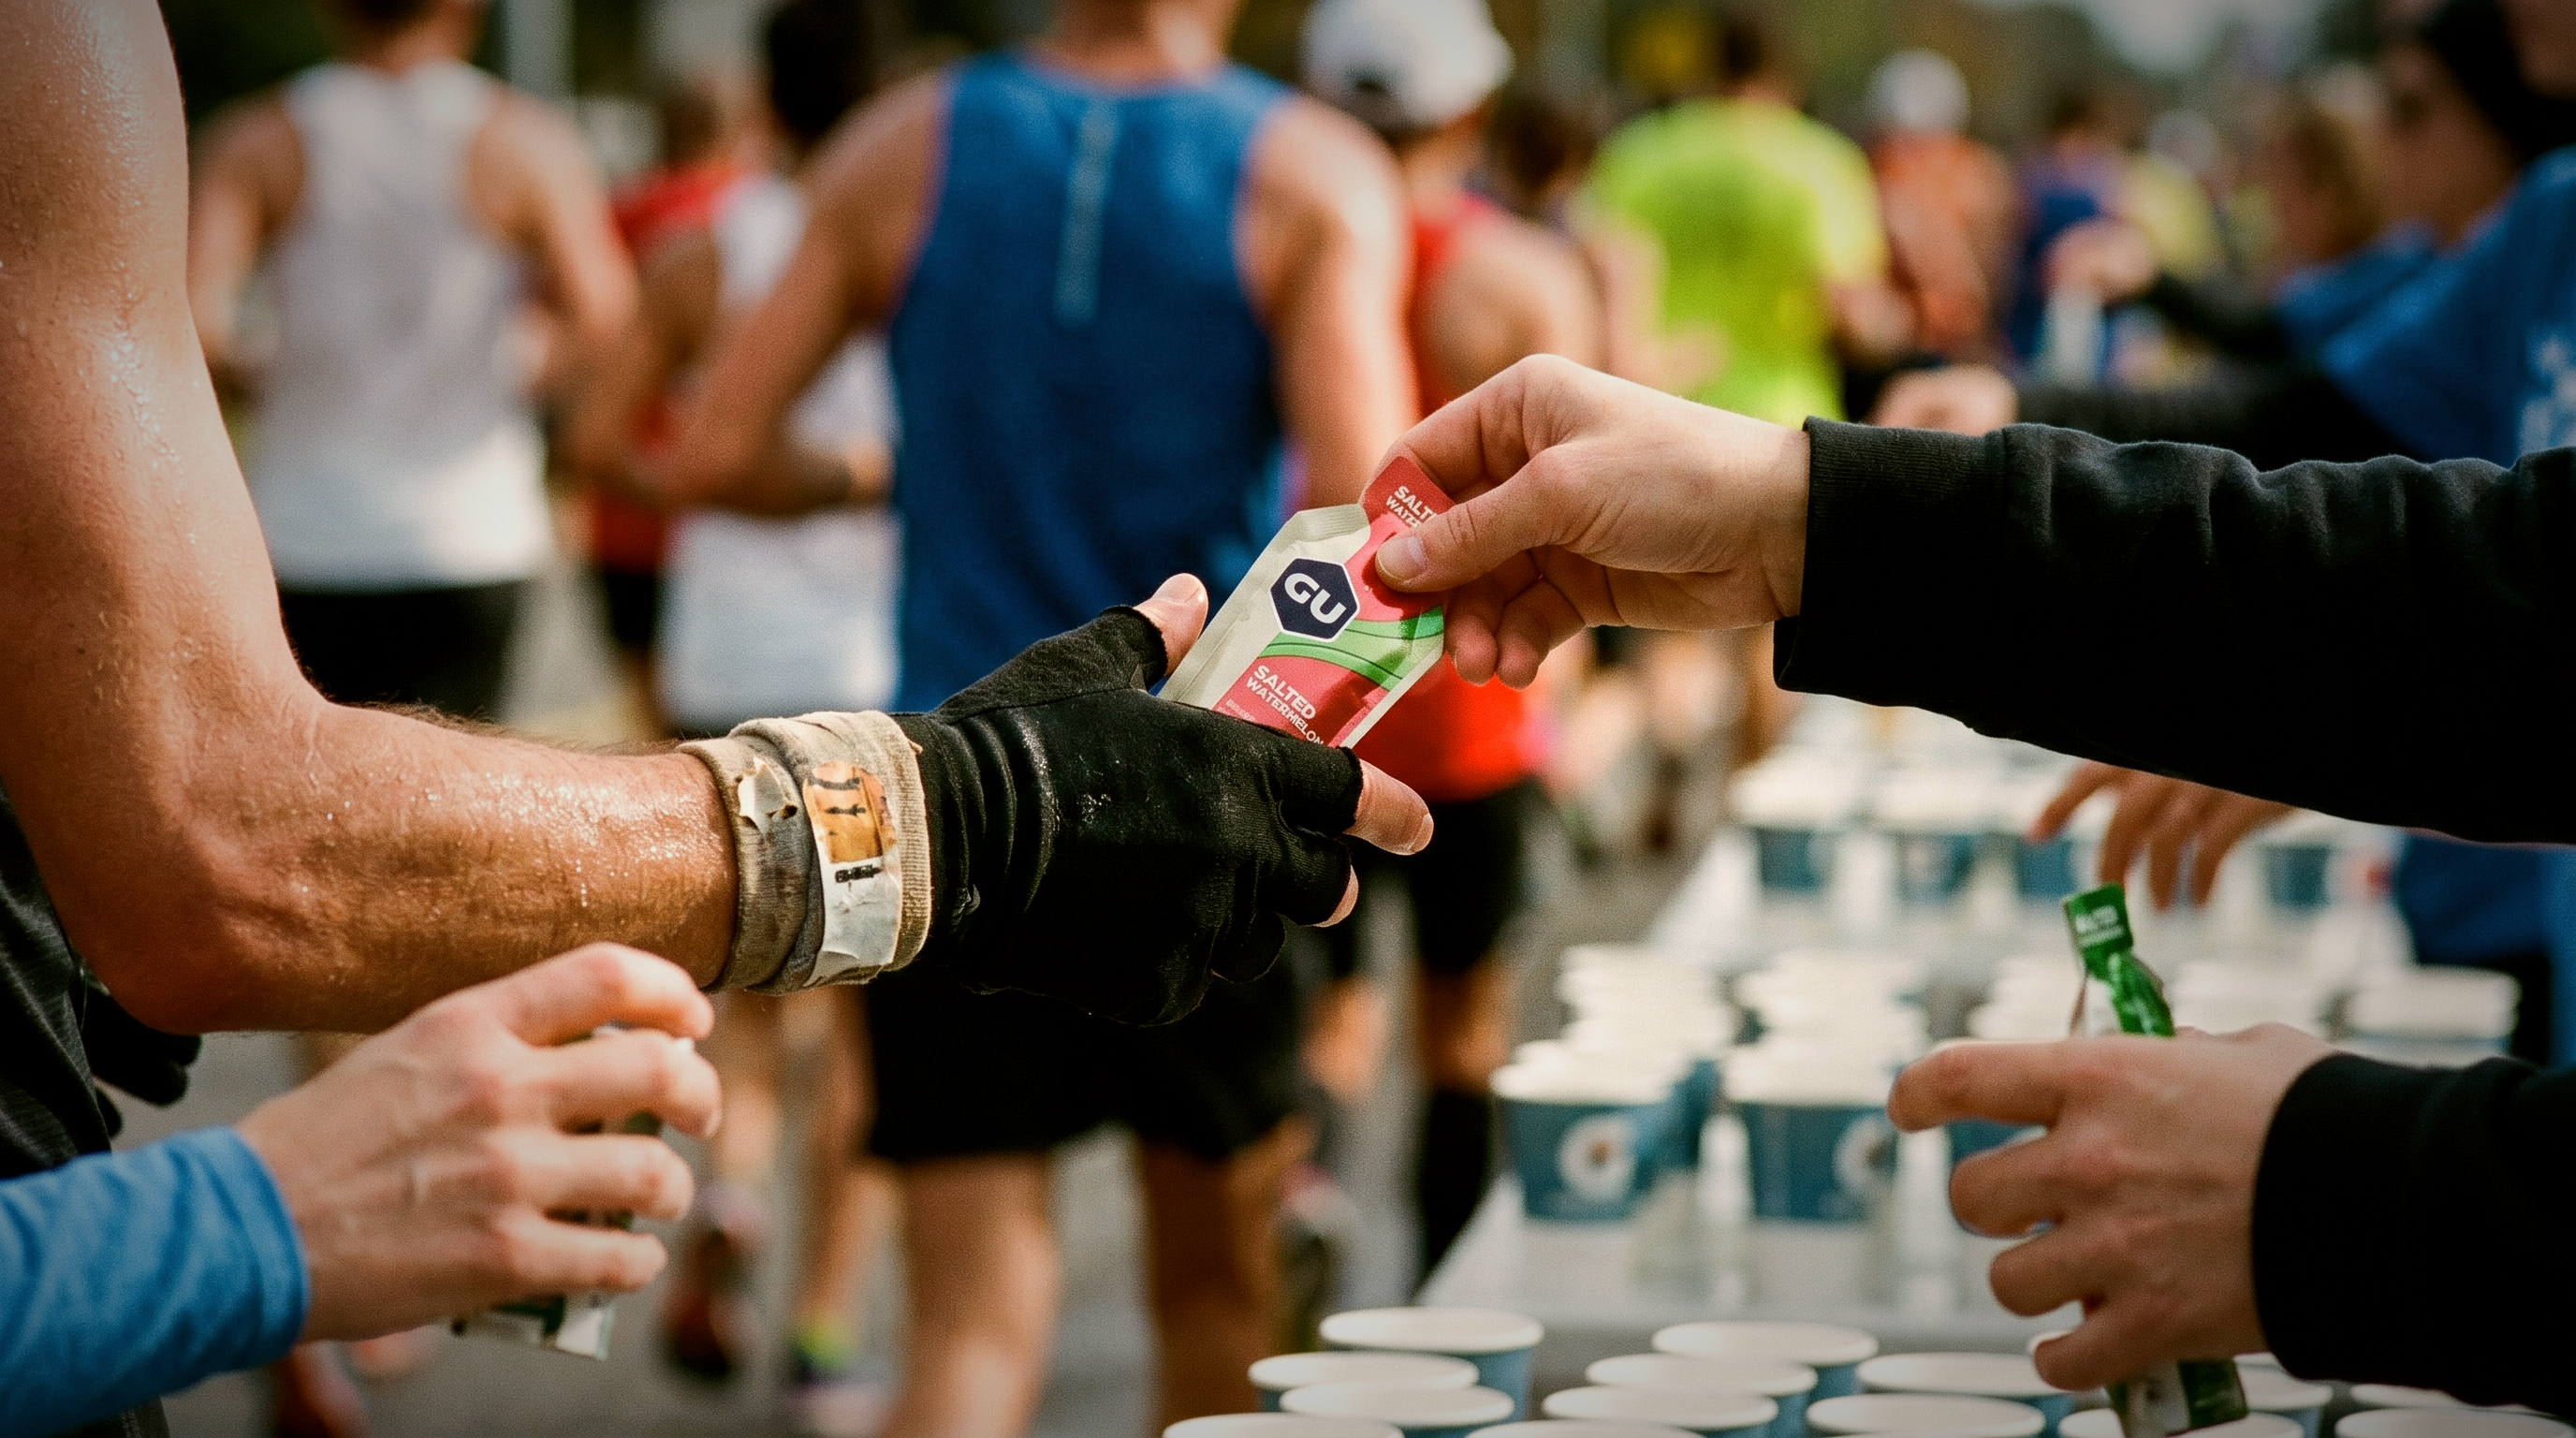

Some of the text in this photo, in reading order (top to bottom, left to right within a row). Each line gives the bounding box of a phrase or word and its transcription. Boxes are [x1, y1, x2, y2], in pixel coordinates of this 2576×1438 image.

[1394, 485, 1436, 521] SALT
[1284, 573, 1347, 624] GU
[1253, 665, 1316, 720] SALTED
